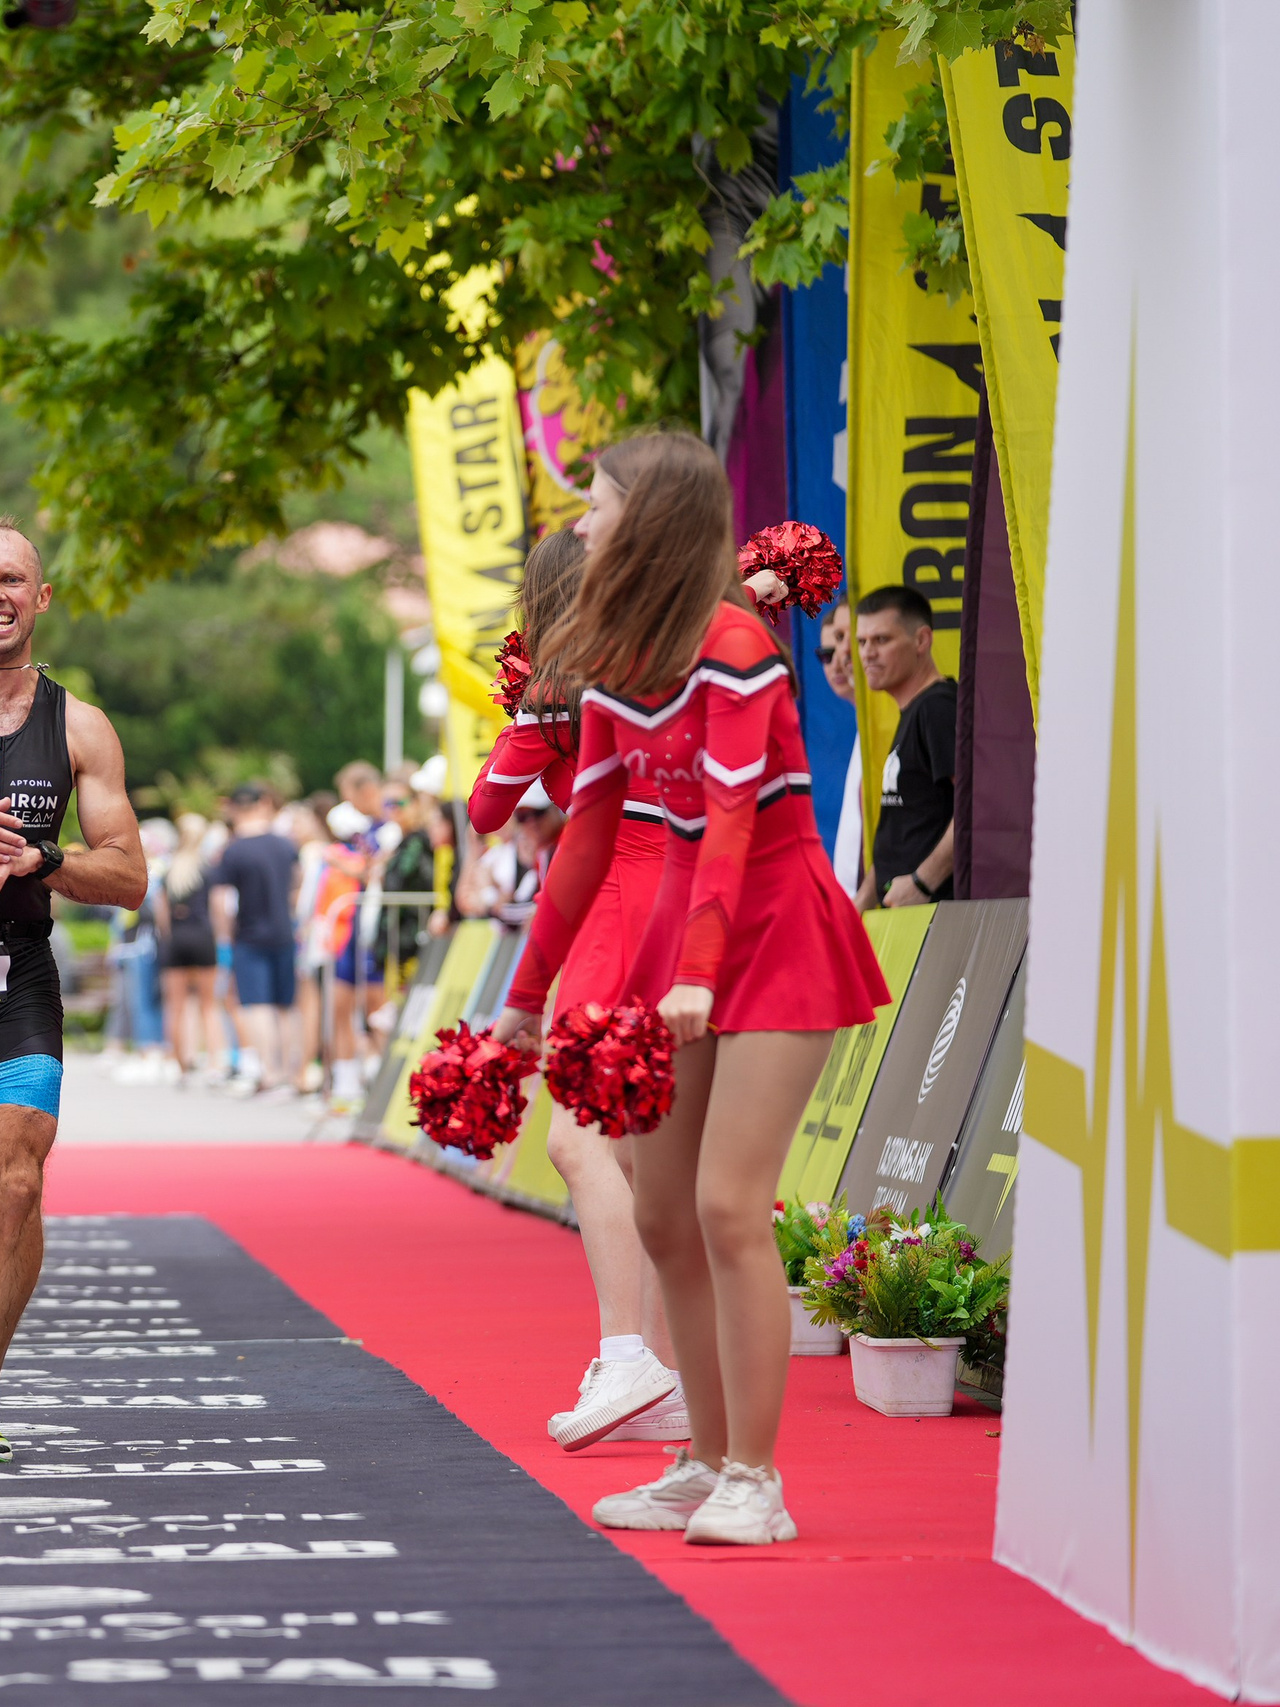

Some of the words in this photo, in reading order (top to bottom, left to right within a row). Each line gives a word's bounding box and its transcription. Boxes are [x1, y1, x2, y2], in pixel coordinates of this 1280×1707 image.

[448, 396, 502, 536] STAR
[10, 779, 53, 788] APTONIA
[11, 792, 58, 810] IRON
[11, 810, 55, 823] TEAM
[19, 1459, 326, 1475] STAR
[41, 1540, 398, 1559] STAR
[67, 1656, 497, 1683] STAR
